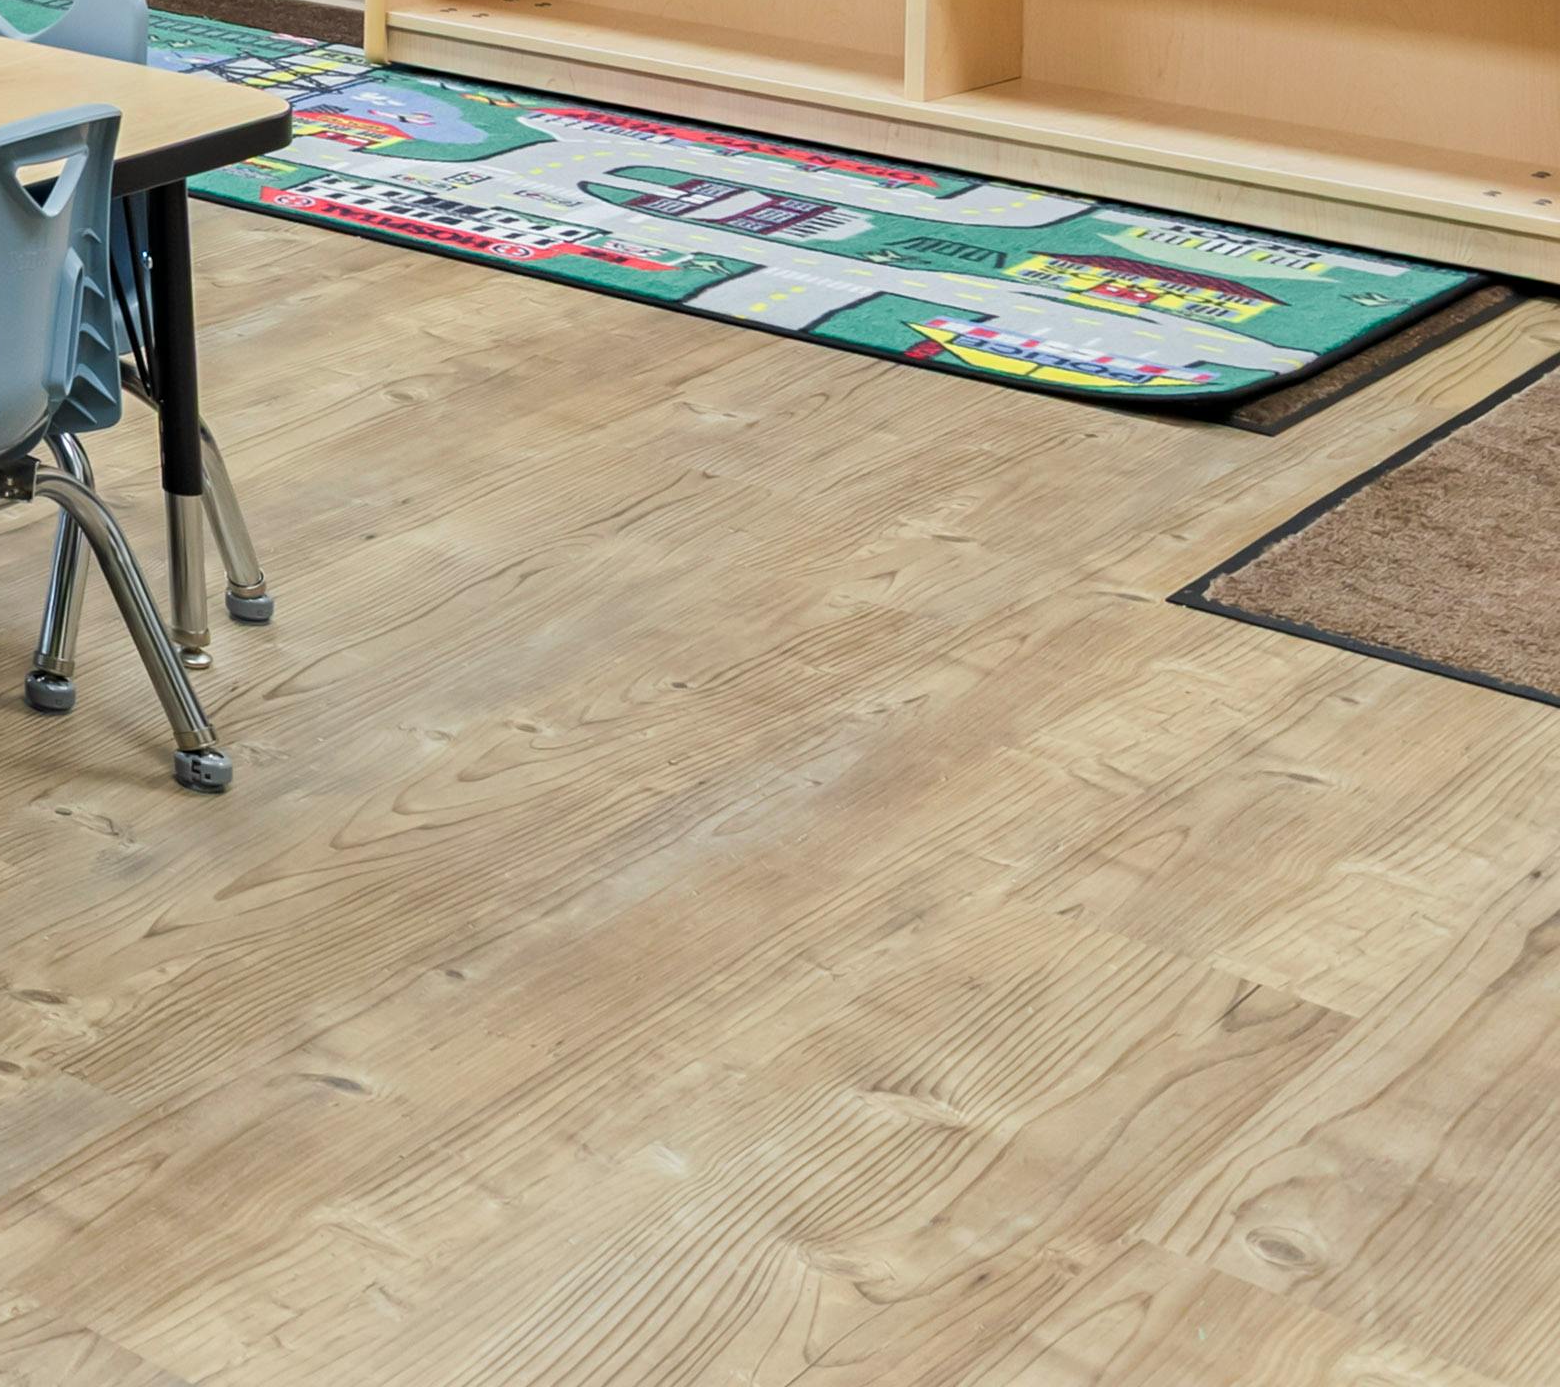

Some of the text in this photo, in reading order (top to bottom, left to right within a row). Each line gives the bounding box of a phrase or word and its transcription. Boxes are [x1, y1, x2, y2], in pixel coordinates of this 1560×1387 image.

[321, 202, 491, 249] HOSPITAL
[1159, 225, 1322, 259] DEPOT
[951, 336, 1148, 383] POLICE
